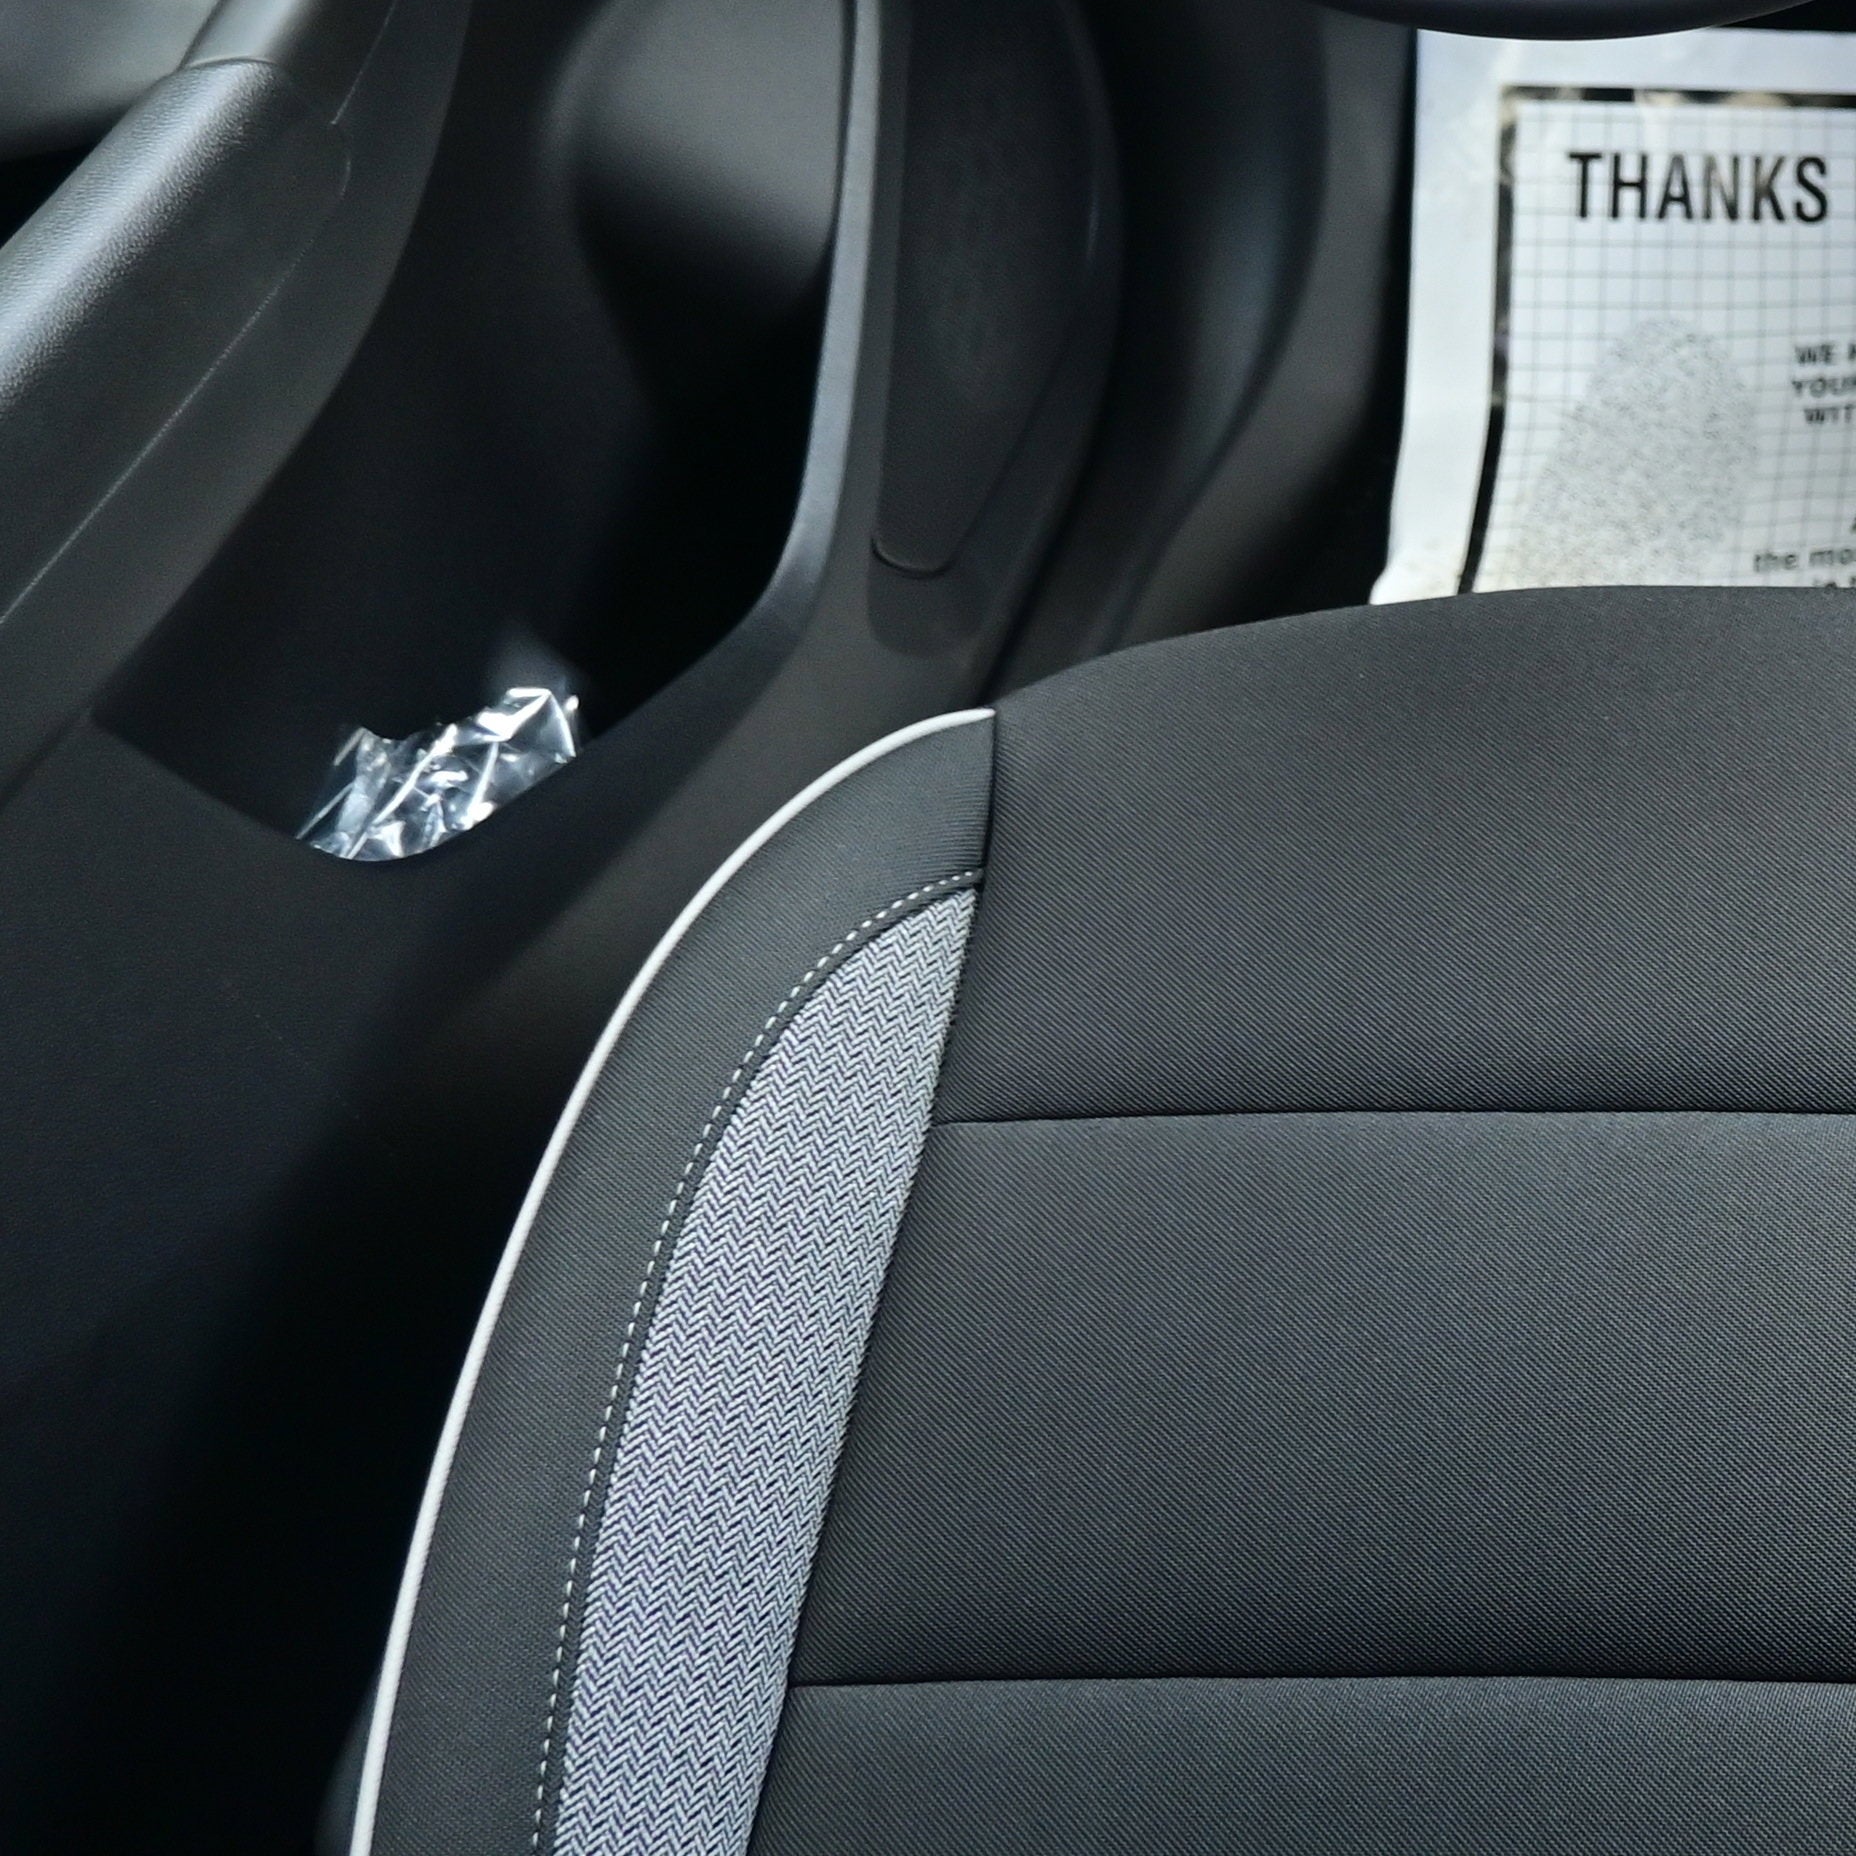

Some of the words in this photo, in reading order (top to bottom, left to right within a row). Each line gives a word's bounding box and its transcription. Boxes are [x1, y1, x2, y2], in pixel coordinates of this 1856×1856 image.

[1569, 151, 1827, 223] THANKS
[1795, 343, 1834, 365] WE
[1754, 551, 1798, 573] the
